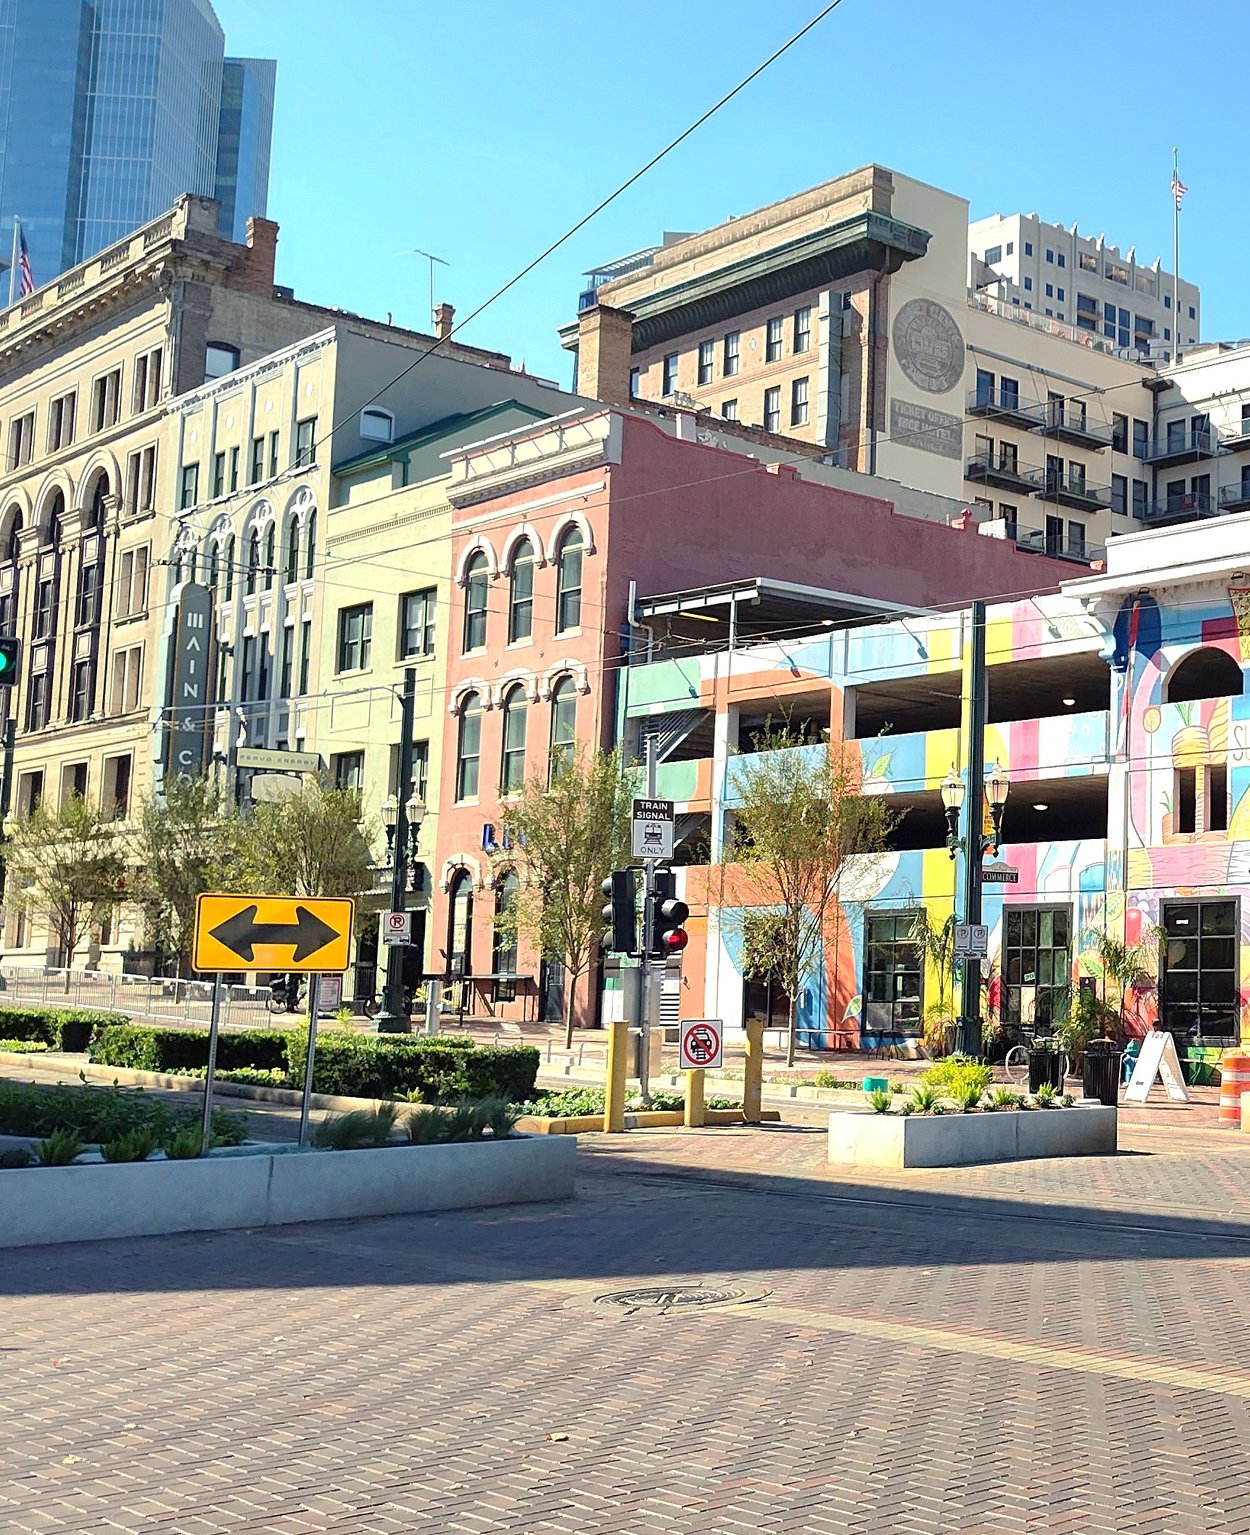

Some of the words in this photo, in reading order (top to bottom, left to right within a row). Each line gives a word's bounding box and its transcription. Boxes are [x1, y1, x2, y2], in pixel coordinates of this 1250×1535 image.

[894, 400, 926, 419] TICKET
[928, 411, 959, 429] OFFICE
[897, 415, 920, 433] RICE
[640, 801, 668, 810] TRAIN
[636, 811, 671, 820] SIGNAL
[640, 846, 665, 854] ONLY
[982, 871, 1018, 882] COMMERCE
